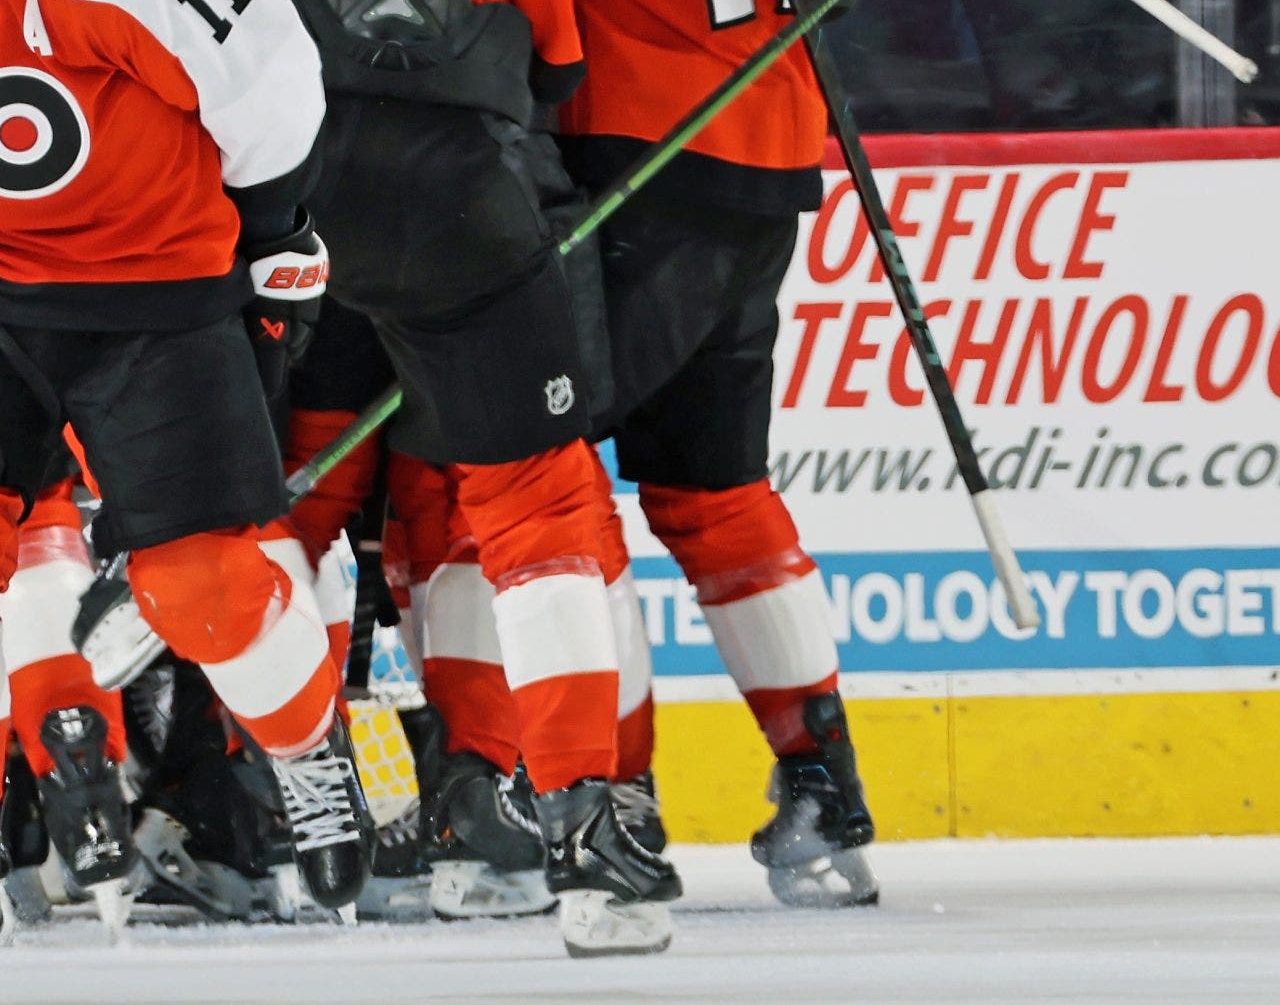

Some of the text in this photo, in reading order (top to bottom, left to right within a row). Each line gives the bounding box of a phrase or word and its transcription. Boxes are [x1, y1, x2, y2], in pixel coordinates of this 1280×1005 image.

[806, 170, 1129, 285] OFFICE
[779, 293, 1280, 409] TECHNOLO
[767, 425, 1280, 495] www.di-inc.co
[634, 570, 1079, 646] TENOLOGY
